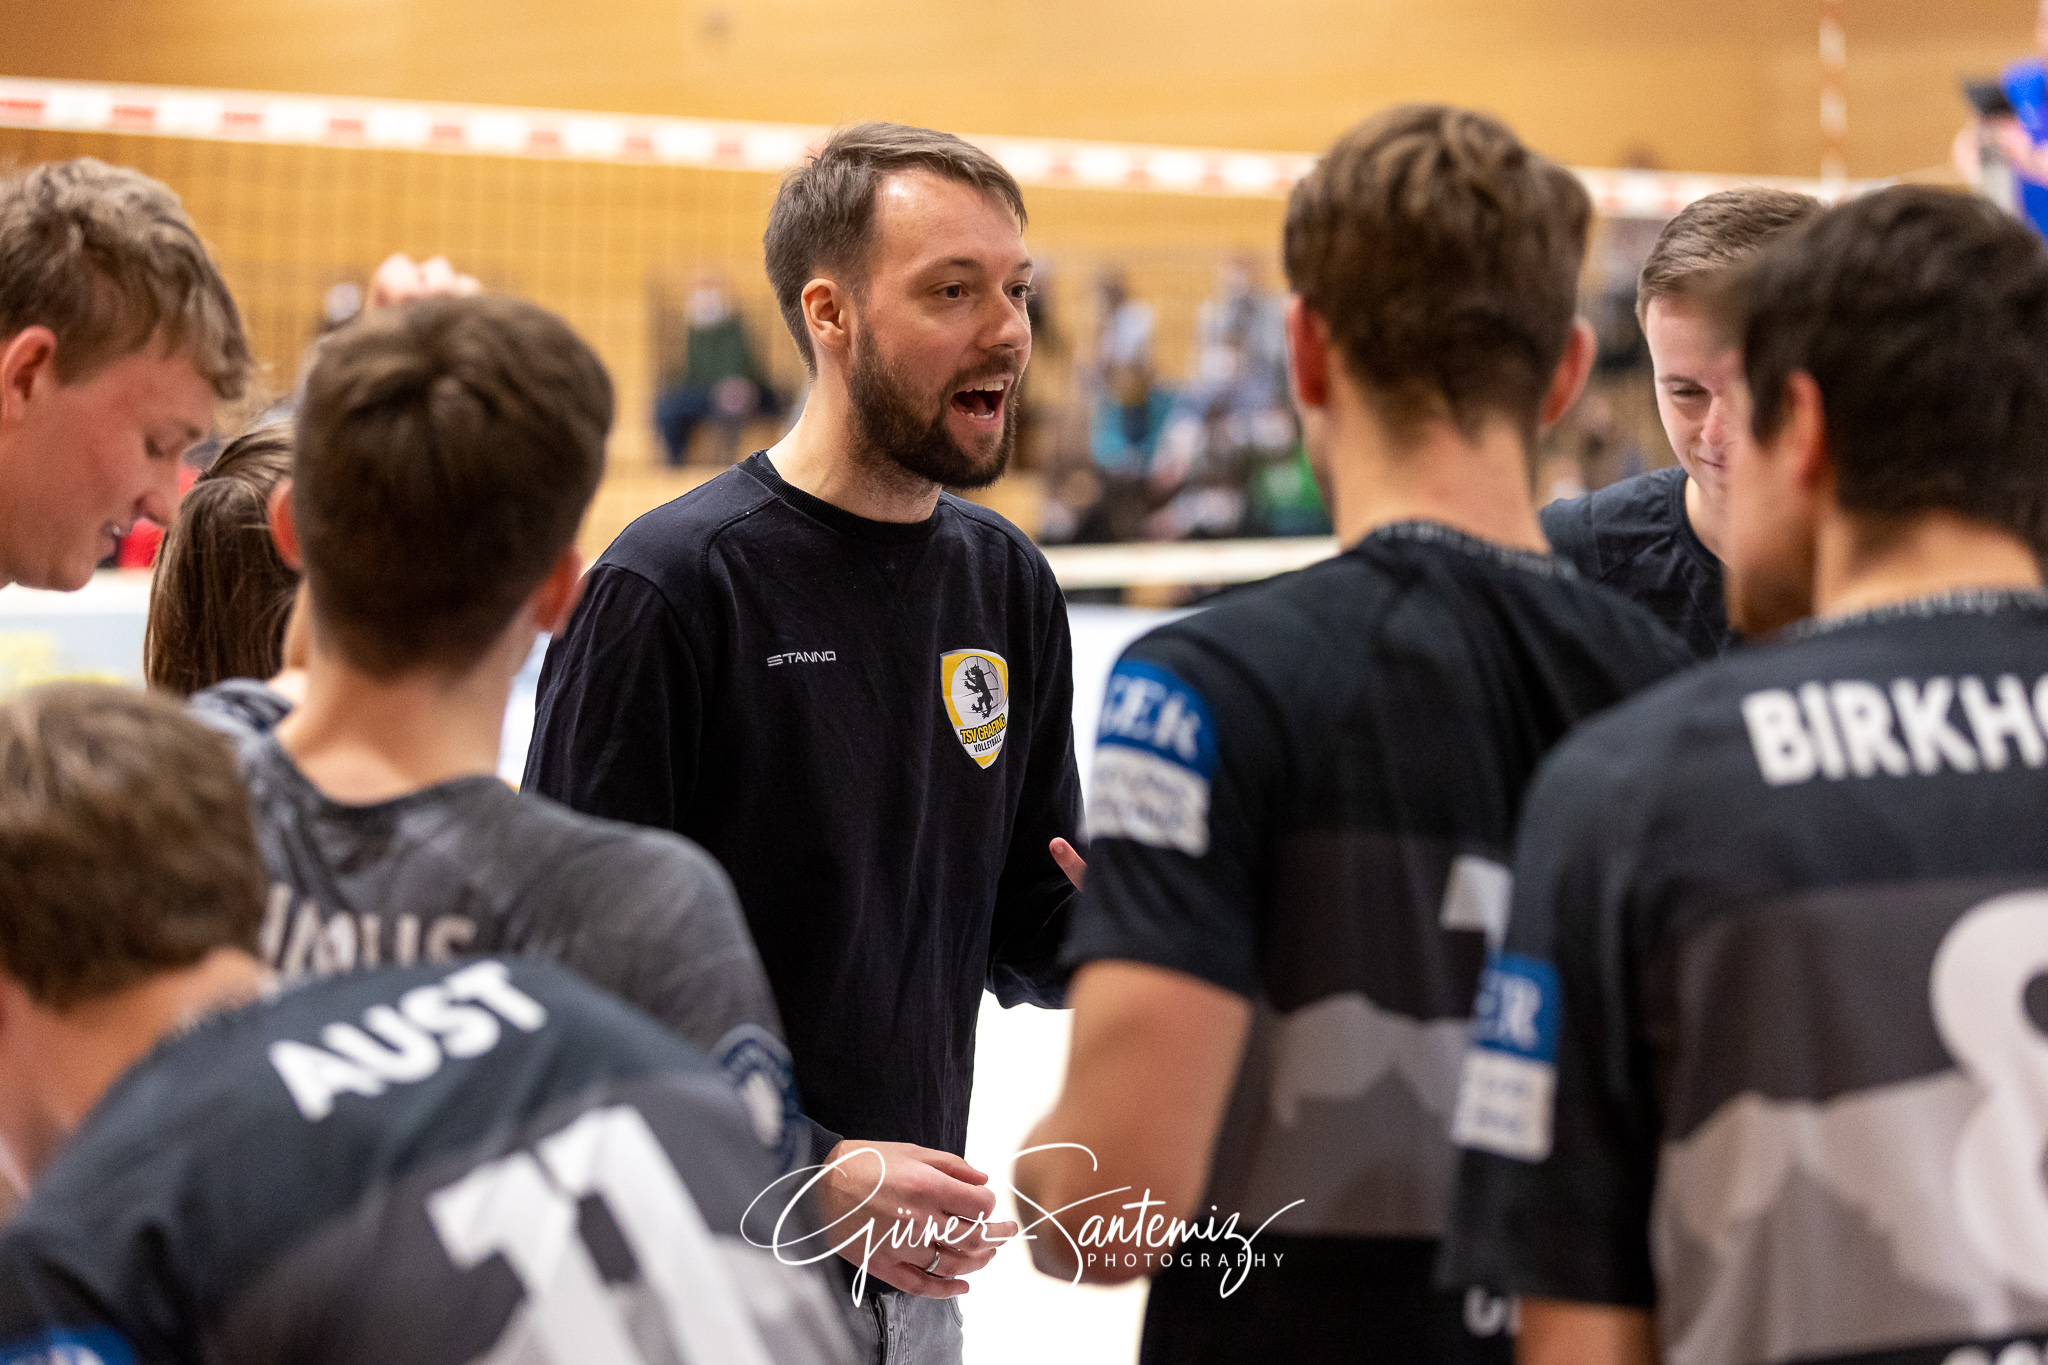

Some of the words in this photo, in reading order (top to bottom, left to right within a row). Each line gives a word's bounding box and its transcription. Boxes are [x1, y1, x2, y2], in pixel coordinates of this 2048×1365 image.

[766, 651, 837, 667] STANNO
[960, 727, 978, 744] TSV
[977, 713, 1006, 741] GRAFING
[974, 734, 1002, 752] VOLLEYBALL
[268, 959, 548, 1122] AUST
